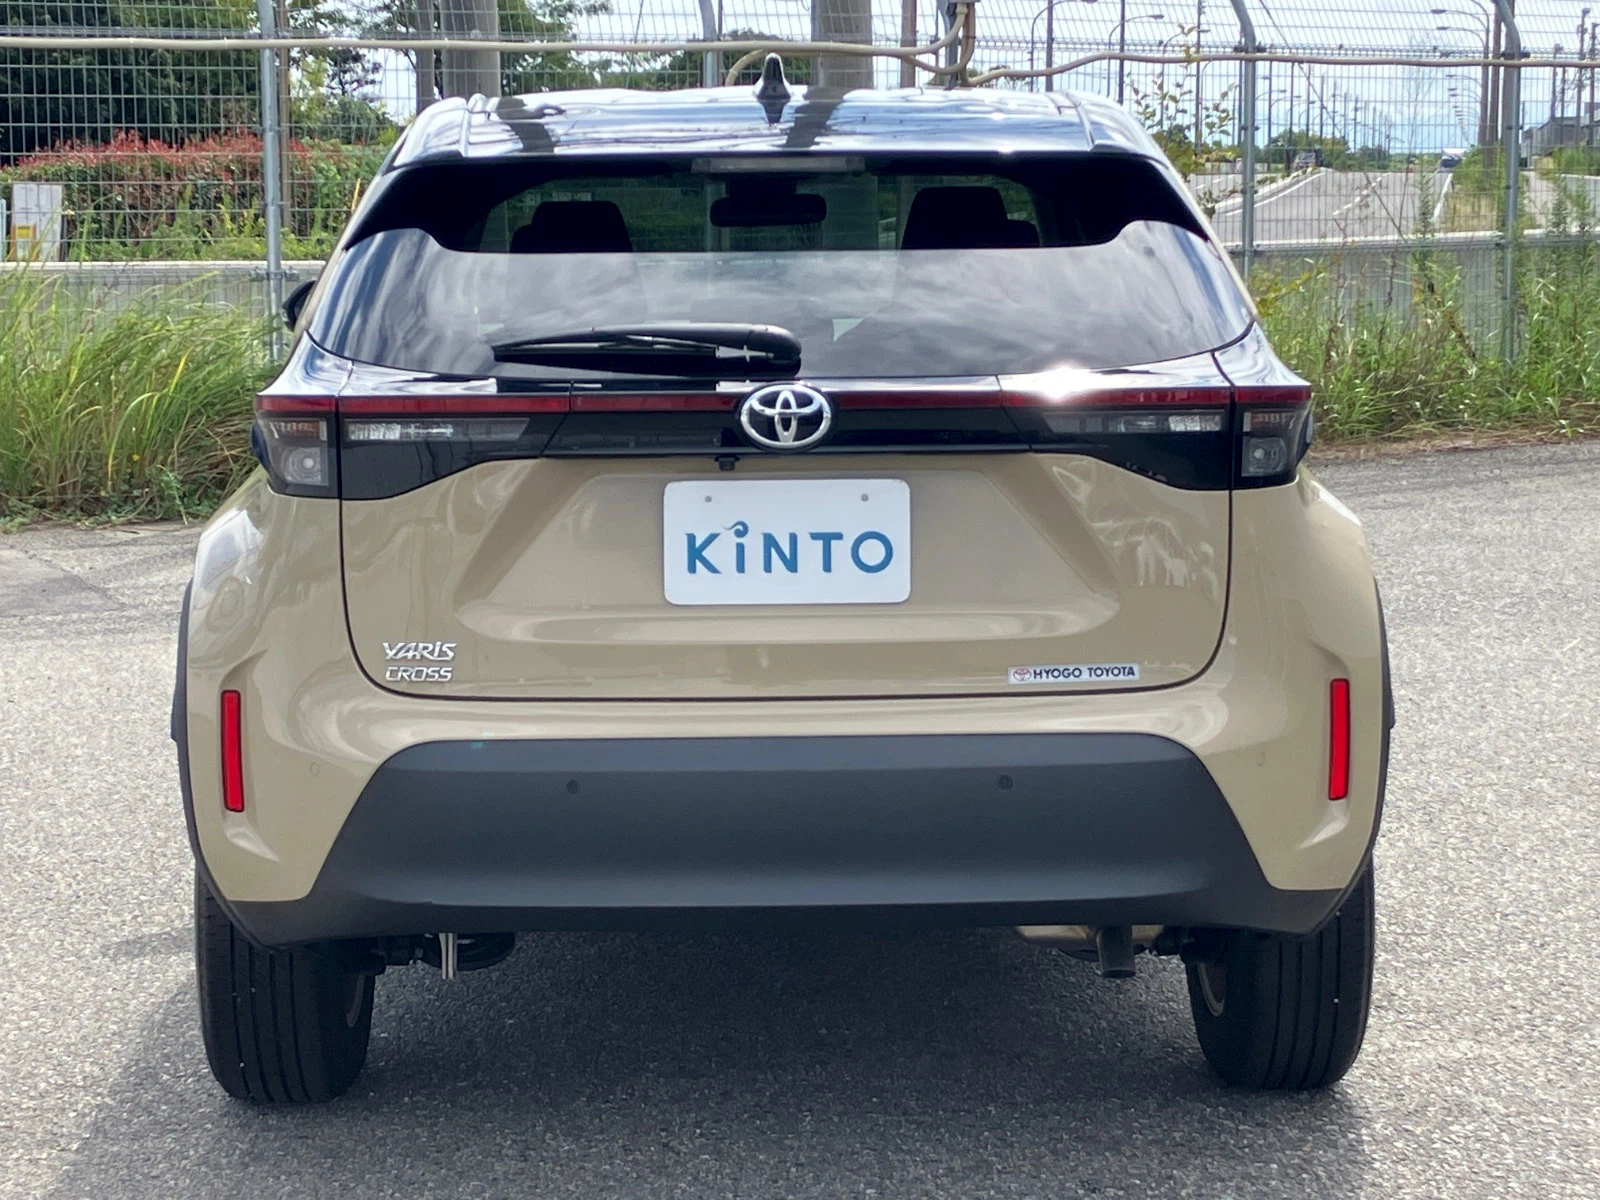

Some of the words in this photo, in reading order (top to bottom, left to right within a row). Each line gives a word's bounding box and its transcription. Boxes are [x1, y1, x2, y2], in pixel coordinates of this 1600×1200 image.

[385, 666, 453, 682] CROSS
[1033, 667, 1082, 679] HYOGO
[1087, 666, 1136, 678] TOYOTA
